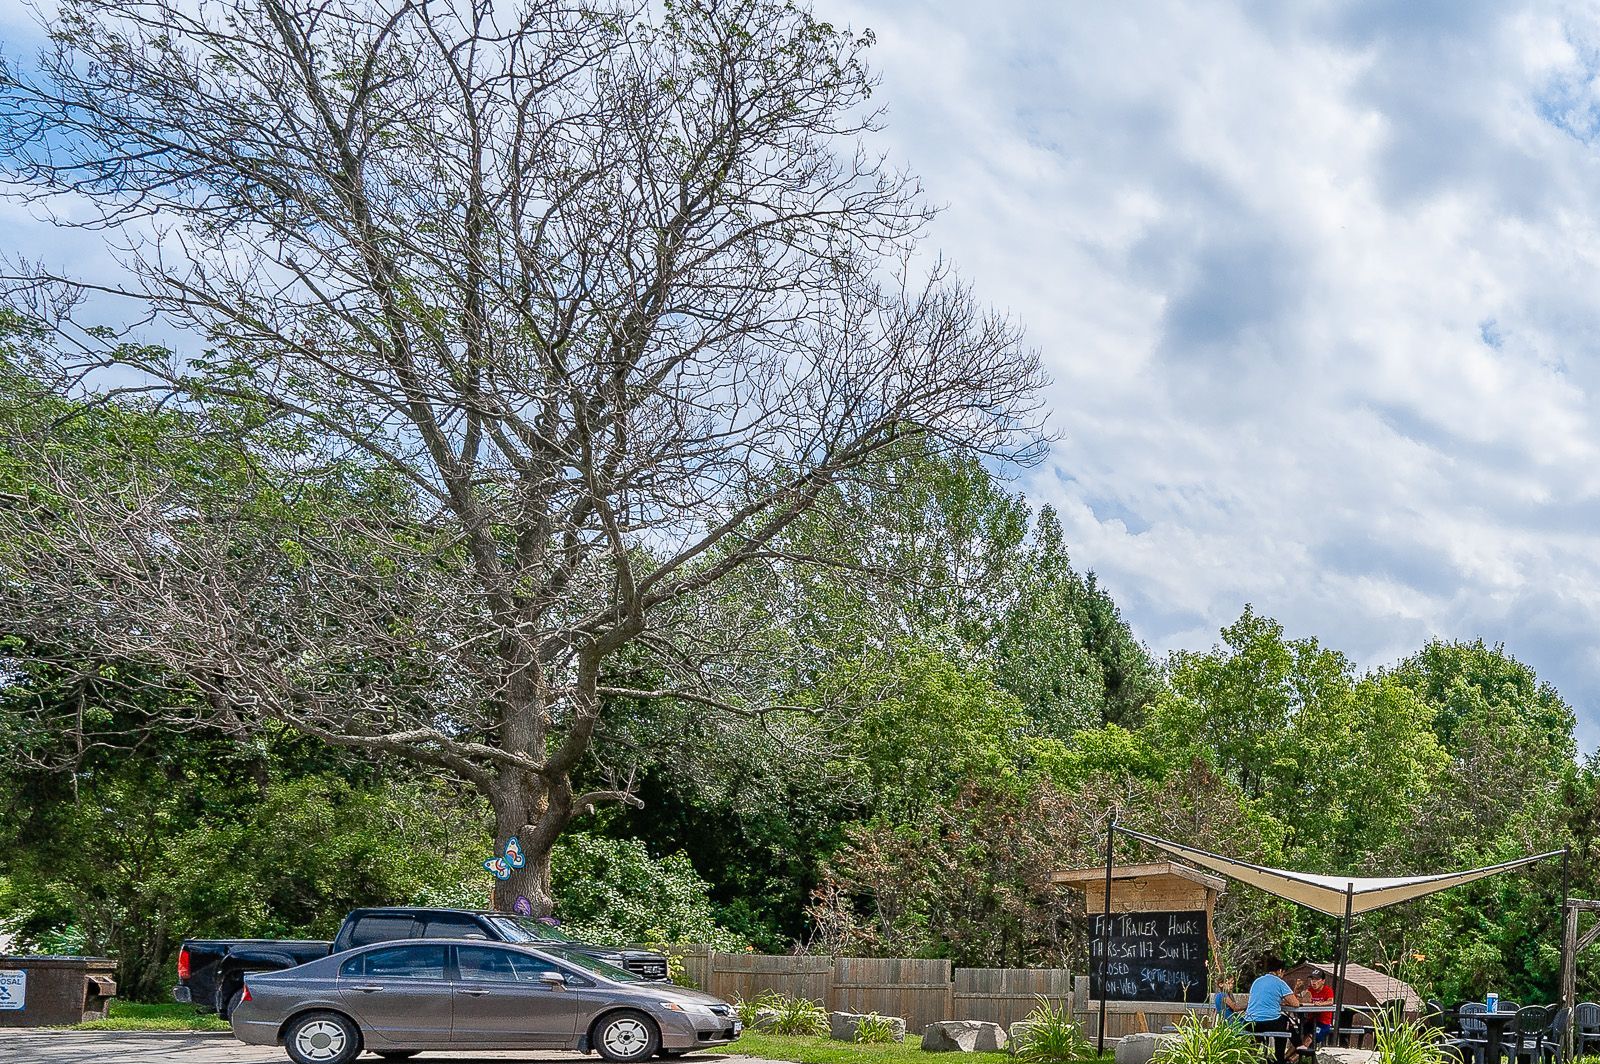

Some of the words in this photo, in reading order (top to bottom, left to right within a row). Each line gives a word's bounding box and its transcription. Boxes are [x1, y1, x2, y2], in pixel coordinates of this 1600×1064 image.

[1117, 914, 1159, 937] TRAILER
[1168, 914, 1200, 936] HOURS
[1091, 938, 1137, 959] THRS-SAT
[1098, 961, 1130, 976] COSED
